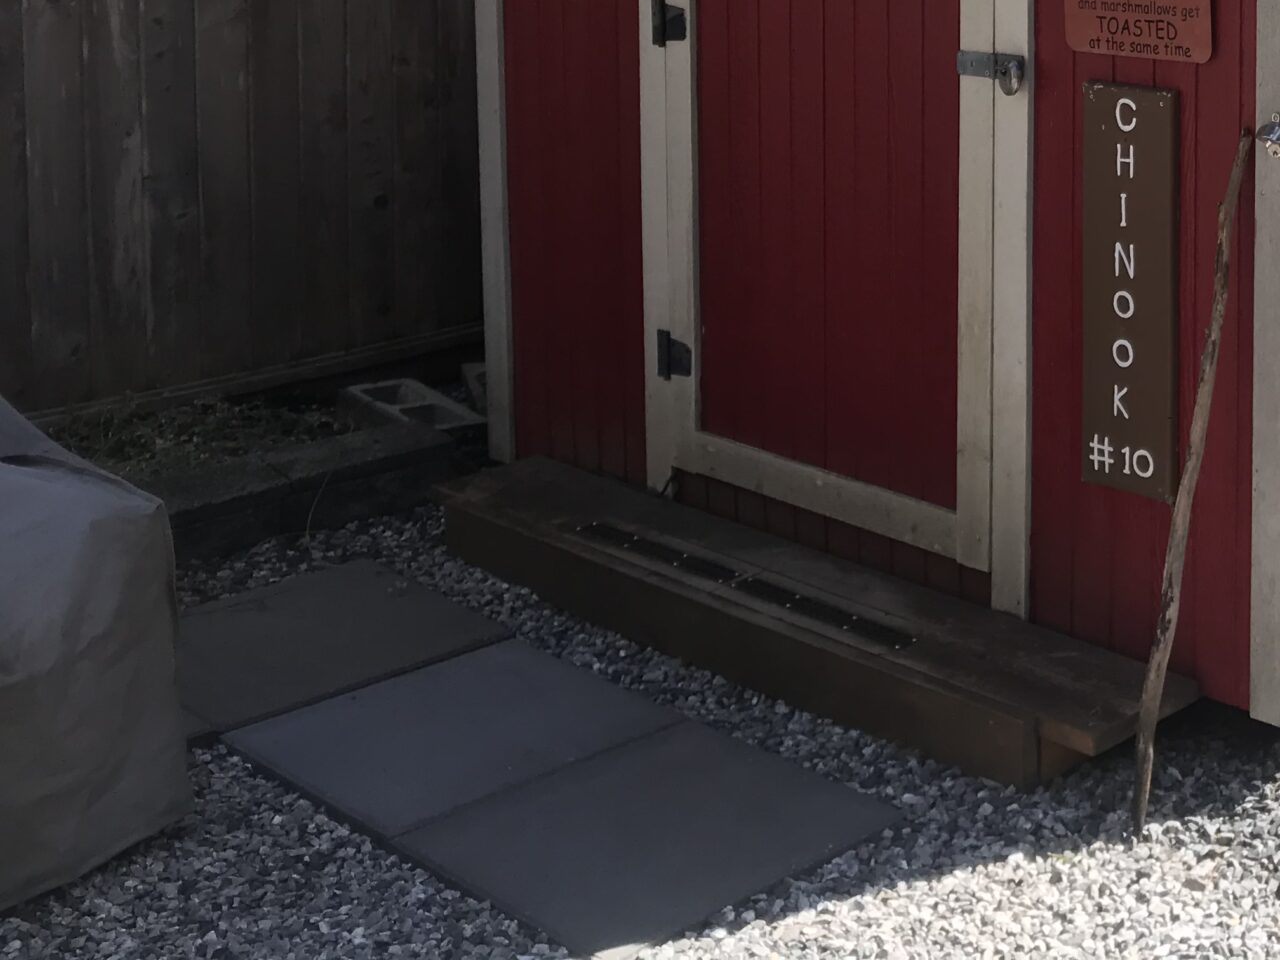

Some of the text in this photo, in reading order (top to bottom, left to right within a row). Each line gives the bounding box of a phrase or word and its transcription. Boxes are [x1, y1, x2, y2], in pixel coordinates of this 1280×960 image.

[1101, 0, 1177, 16] marshmallows
[1181, 5, 1201, 22] get
[1096, 16, 1178, 40] TOASTED
[1089, 36, 1192, 58] at the same time
[1112, 98, 1137, 419] CHINOOK
[1089, 434, 1154, 478] #10
